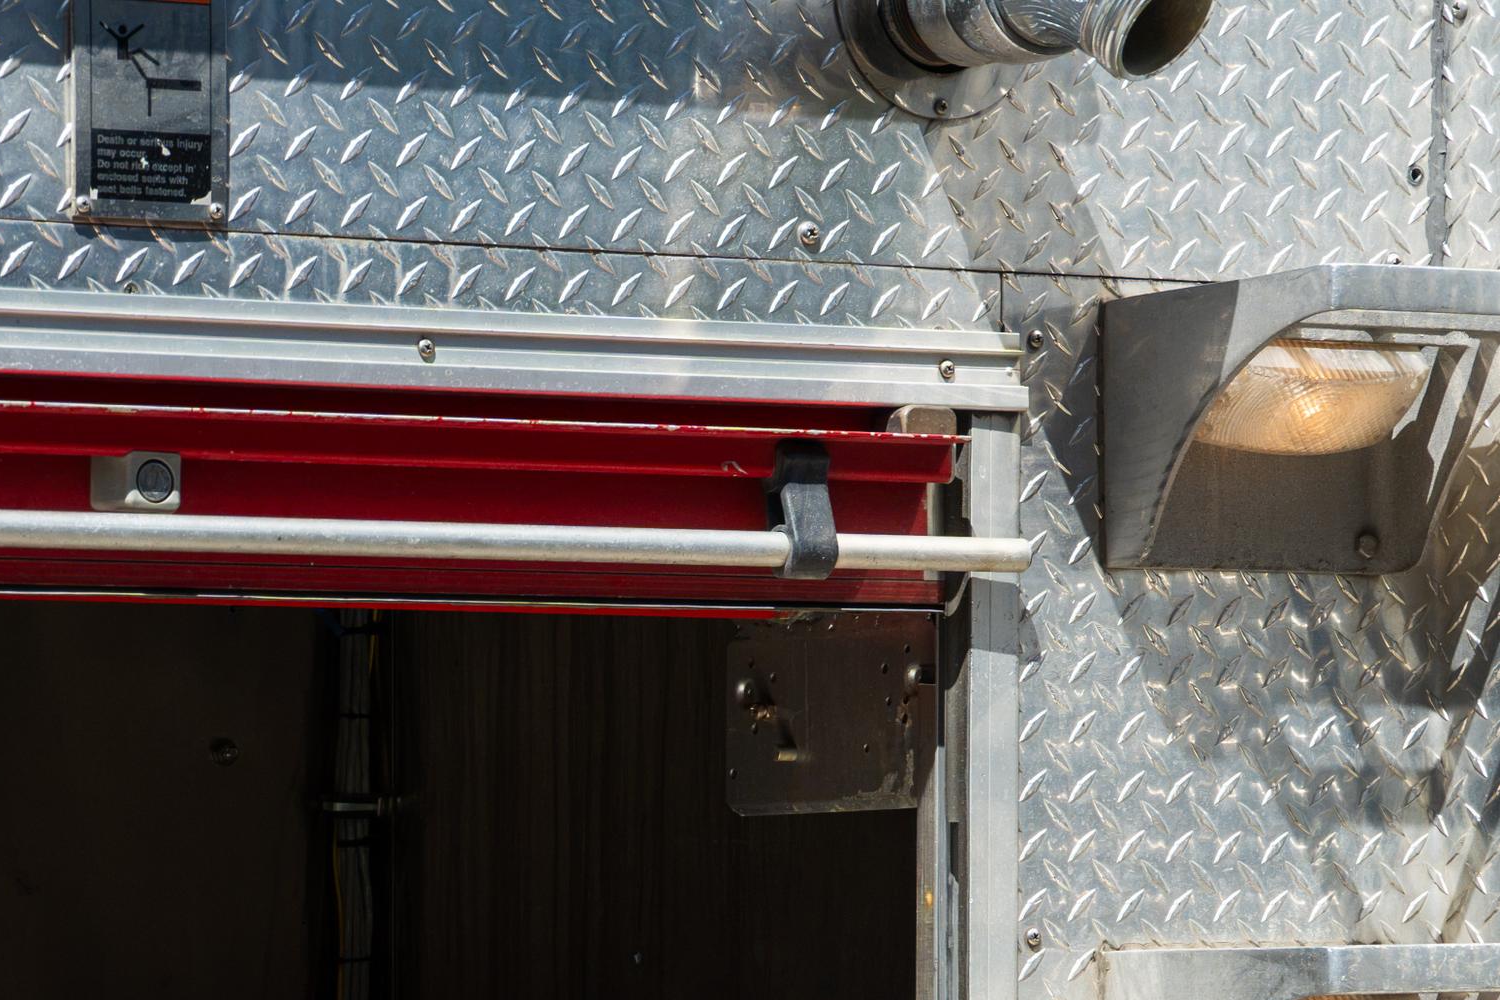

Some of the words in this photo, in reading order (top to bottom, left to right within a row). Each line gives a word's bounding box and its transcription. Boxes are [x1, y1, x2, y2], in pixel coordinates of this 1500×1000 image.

[97, 134, 124, 145] Death
[126, 137, 137, 145] or
[176, 138, 204, 151] injury
[97, 148, 116, 159] may
[119, 150, 148, 158] occur.
[97, 159, 110, 168] Do
[113, 160, 128, 170] not
[151, 162, 182, 174] except
[185, 164, 194, 174] in
[97, 172, 139, 182] enclosed
[168, 176, 188, 185] with
[119, 184, 142, 194] belts
